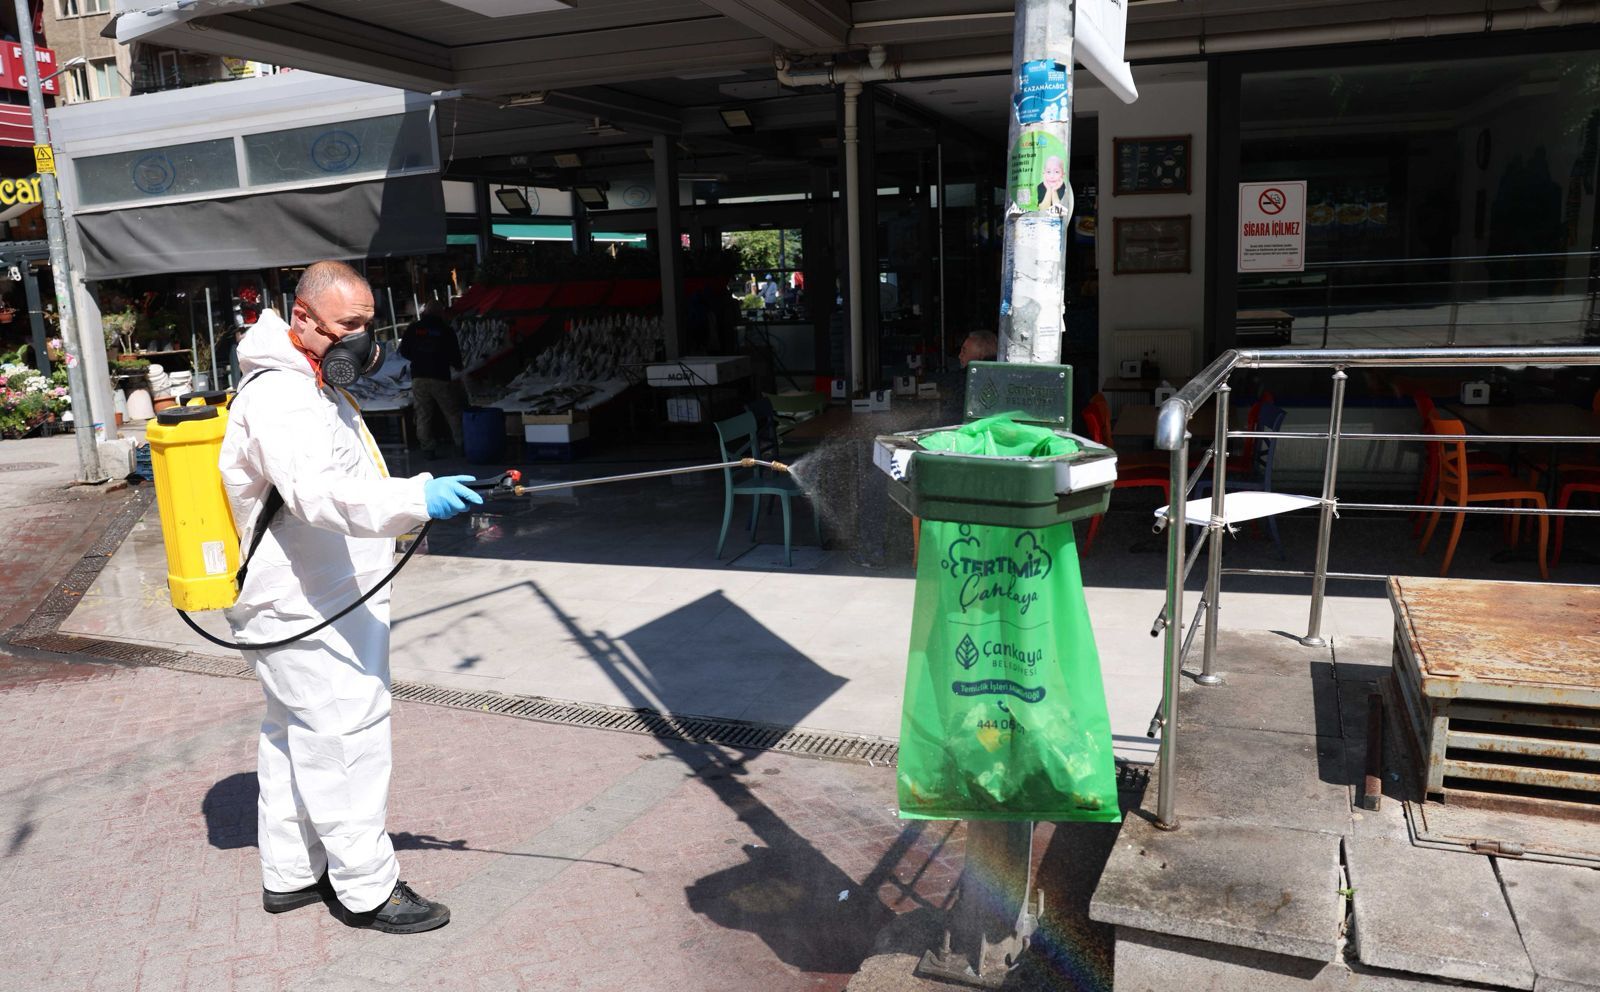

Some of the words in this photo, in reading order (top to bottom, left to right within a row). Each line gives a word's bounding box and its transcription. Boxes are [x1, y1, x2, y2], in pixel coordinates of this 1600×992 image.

[13, 46, 51, 63] FIN
[18, 75, 54, 91] CFE
[1243, 221, 1270, 237] SİGARA
[1272, 220, 1300, 238] İÇİLMEZ
[959, 573, 1040, 615] Çankaya
[982, 640, 1043, 667] Çankaya
[977, 719, 998, 729] 444
